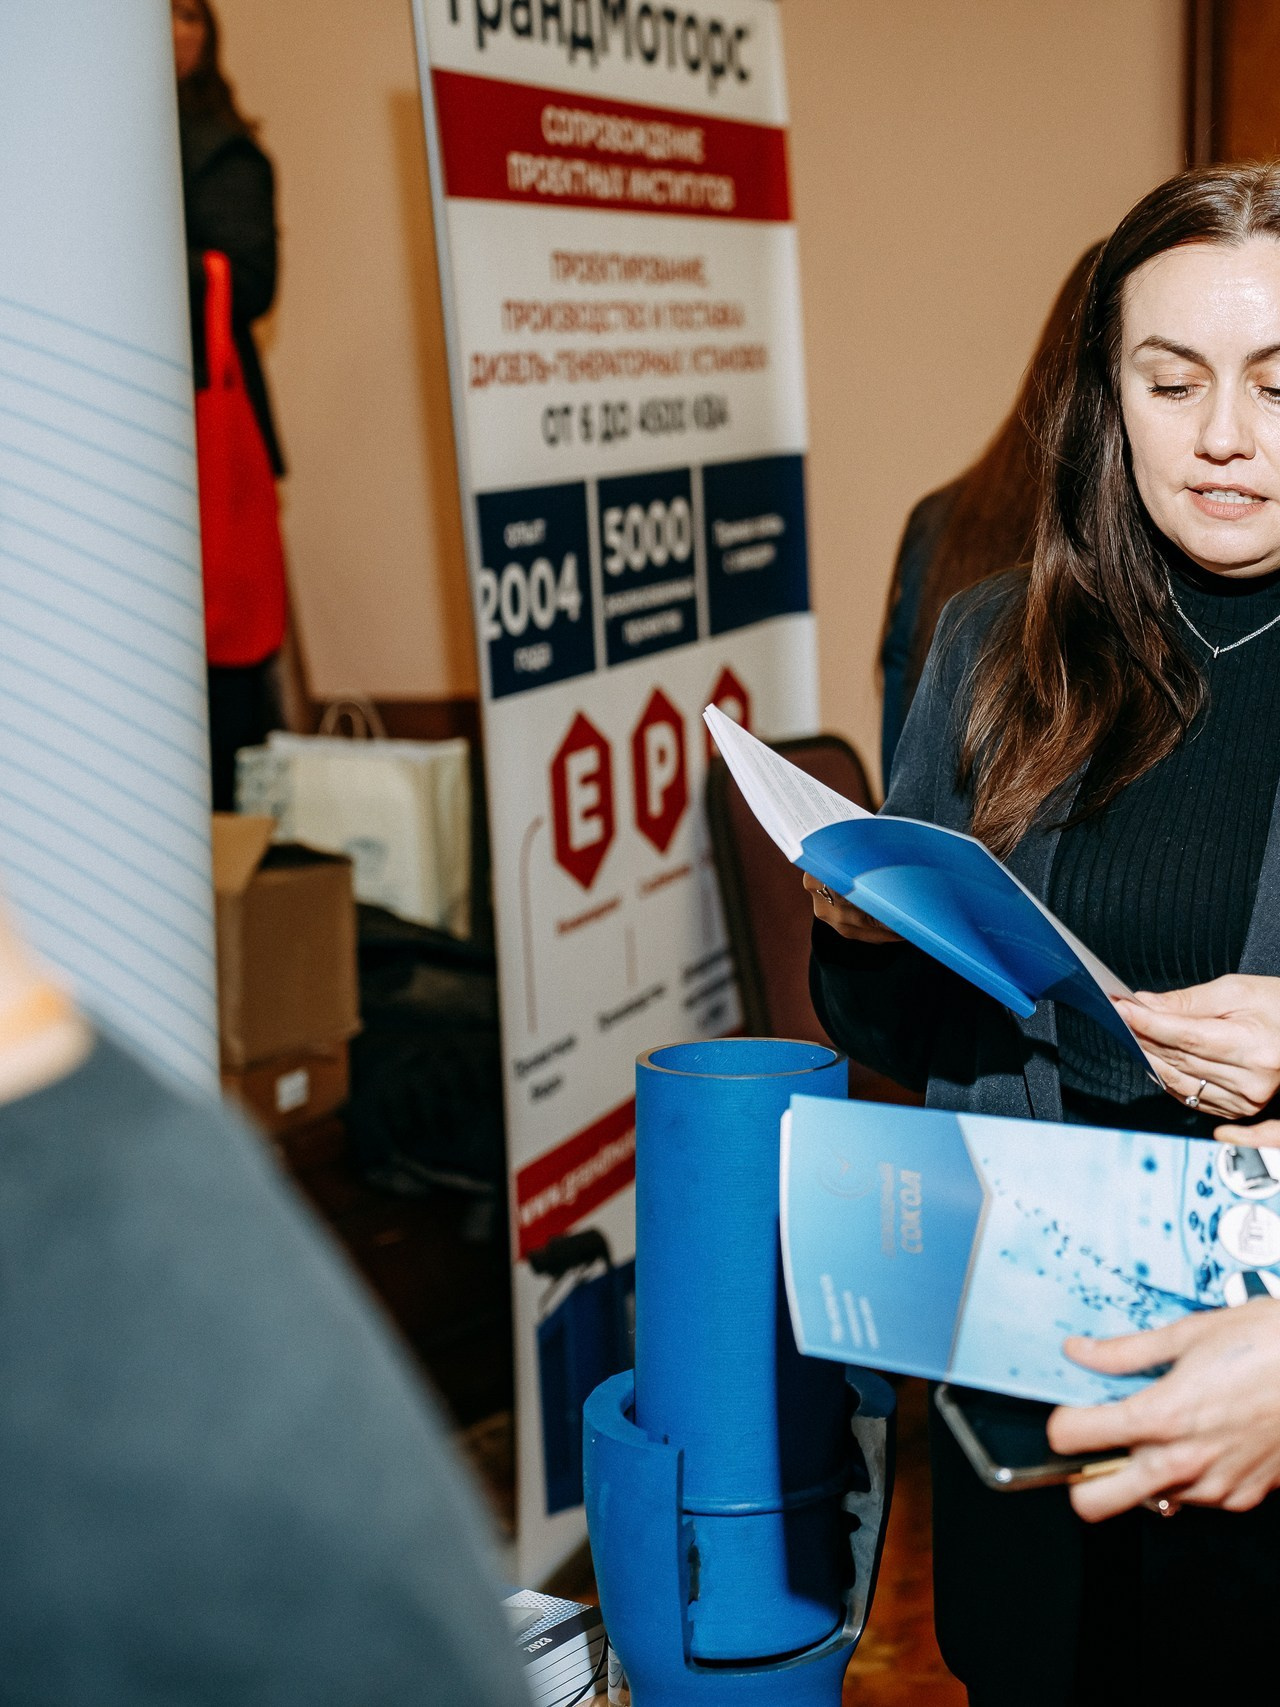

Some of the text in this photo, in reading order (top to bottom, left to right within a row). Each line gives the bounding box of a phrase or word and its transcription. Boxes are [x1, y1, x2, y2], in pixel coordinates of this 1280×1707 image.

[541, 403, 573, 447] ОТ
[603, 496, 691, 576] 5000
[479, 553, 581, 640] 2004
